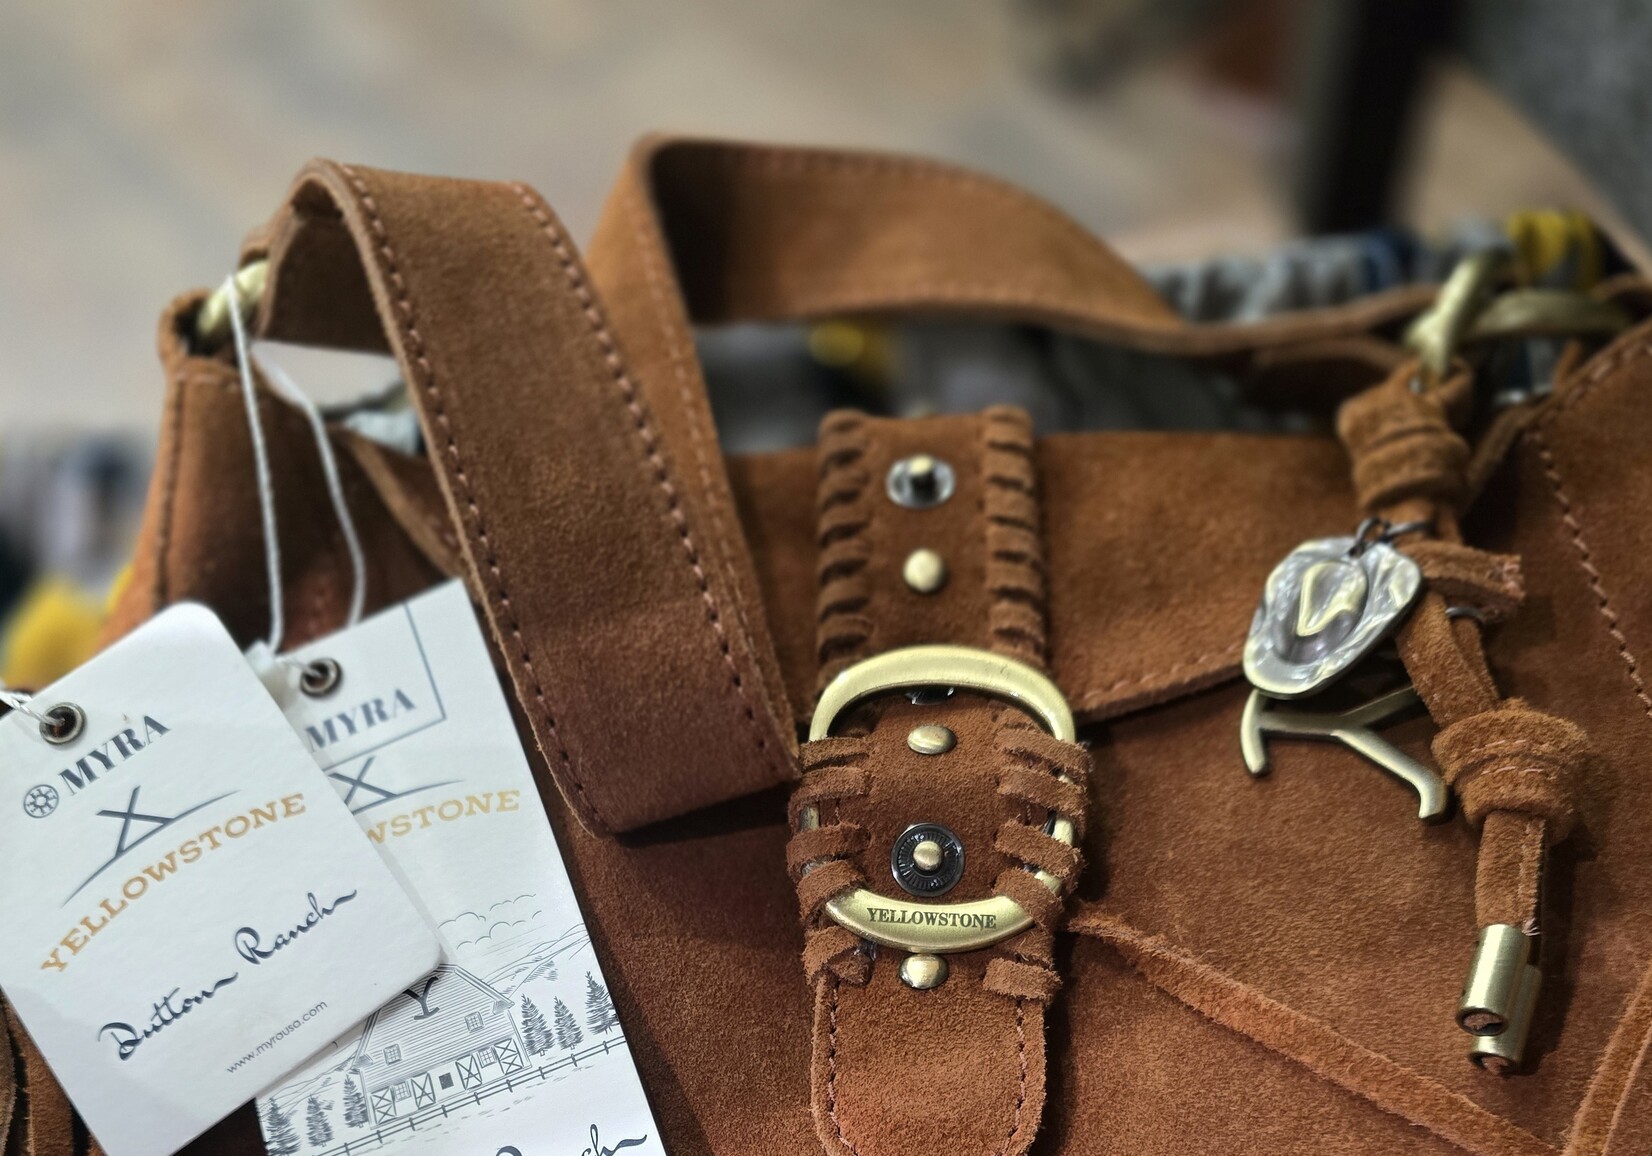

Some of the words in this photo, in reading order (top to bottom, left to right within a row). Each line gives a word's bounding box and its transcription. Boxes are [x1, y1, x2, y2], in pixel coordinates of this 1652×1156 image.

[57, 715, 171, 796] MYRA
[305, 688, 416, 752] MYRA
[367, 789, 521, 844] WSTONE
[41, 793, 307, 974] YELLOWSTONE
[867, 907, 997, 929] YELLOWSTONE
[97, 971, 239, 1061] Dutton
[234, 889, 358, 965] Ranch
[227, 1000, 328, 1074] www.myrausa.com
